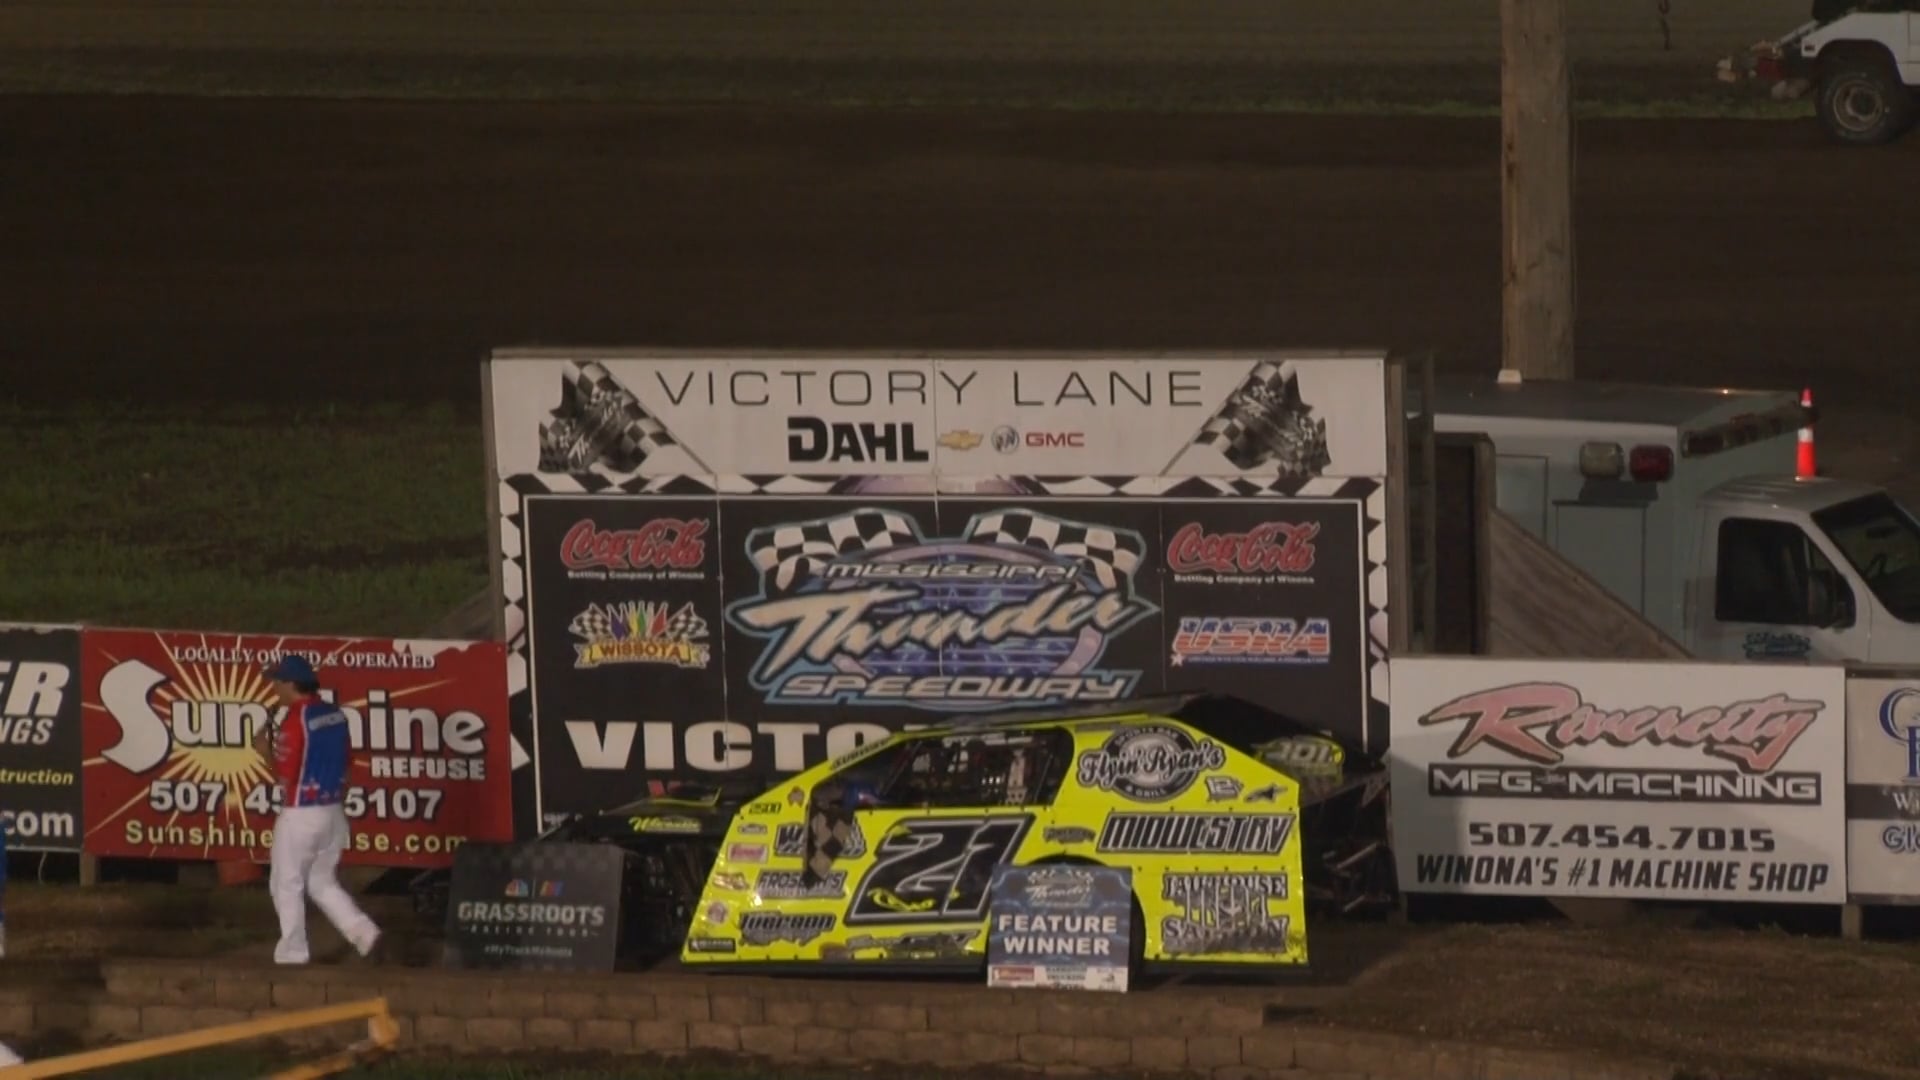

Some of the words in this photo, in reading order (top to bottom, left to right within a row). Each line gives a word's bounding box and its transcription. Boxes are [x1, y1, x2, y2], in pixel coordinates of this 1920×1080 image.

[655, 370, 977, 406] VICTORY
[1014, 371, 1203, 406] LANE
[788, 417, 929, 462] DAHL
[1025, 432, 1085, 448] GMC
[608, 571, 653, 580] Company
[656, 571, 666, 579] of
[668, 571, 704, 579] Winona
[1174, 574, 1214, 585] Bottling
[1216, 574, 1262, 585] Company
[1264, 575, 1275, 584] of
[1276, 575, 1315, 584] Winona
[737, 585, 1132, 680] Thunder
[174, 646, 254, 664] LOCALLY
[327, 652, 338, 667] &
[343, 653, 436, 670] OPERATED
[599, 641, 681, 657] WISSOTA
[780, 675, 1128, 699] SPEEDWAY
[565, 720, 938, 771] VICTO
[371, 756, 486, 780] REFUSE
[150, 780, 226, 813] 507
[1433, 768, 1542, 793] MFG.
[1568, 771, 1817, 800] MACHINING
[1469, 822, 1776, 853] 507.454.7015
[1417, 854, 1559, 886] WINONA'S
[1567, 862, 1600, 889] #1
[1608, 860, 1740, 891] MACHINE
[1749, 863, 1830, 893] SHOP
[458, 900, 606, 927] GRASSROOTS
[998, 913, 1117, 934] FEATURE
[1003, 936, 1110, 956] WINNER
